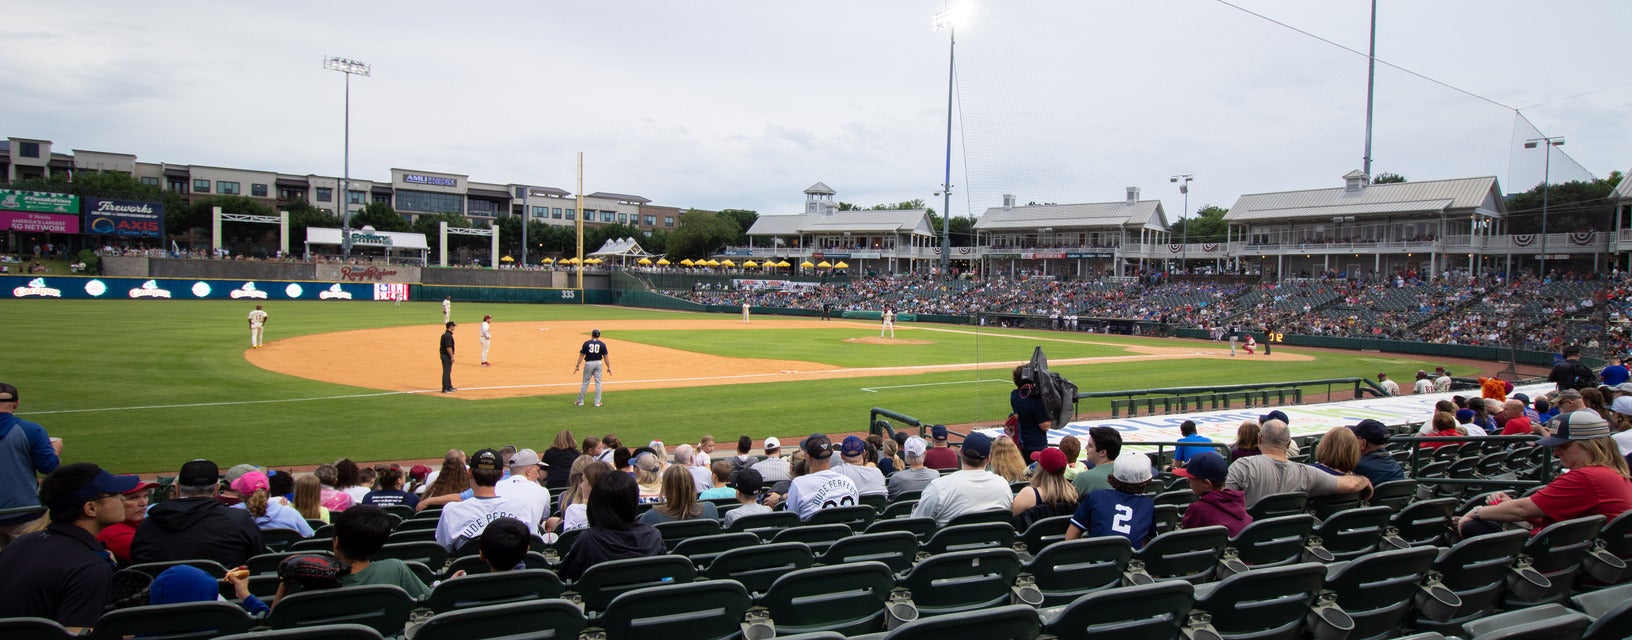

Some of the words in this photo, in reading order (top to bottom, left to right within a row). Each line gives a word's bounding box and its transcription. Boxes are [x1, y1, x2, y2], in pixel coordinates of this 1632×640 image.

[98, 201, 153, 214] Fireworks
[24, 224, 66, 232] NETWORK
[117, 220, 159, 231] AXIS
[561, 290, 575, 299] 335
[588, 343, 601, 354] 30
[812, 484, 830, 506] DUDE
[828, 479, 858, 497] PERFECT
[1111, 503, 1133, 535] 2
